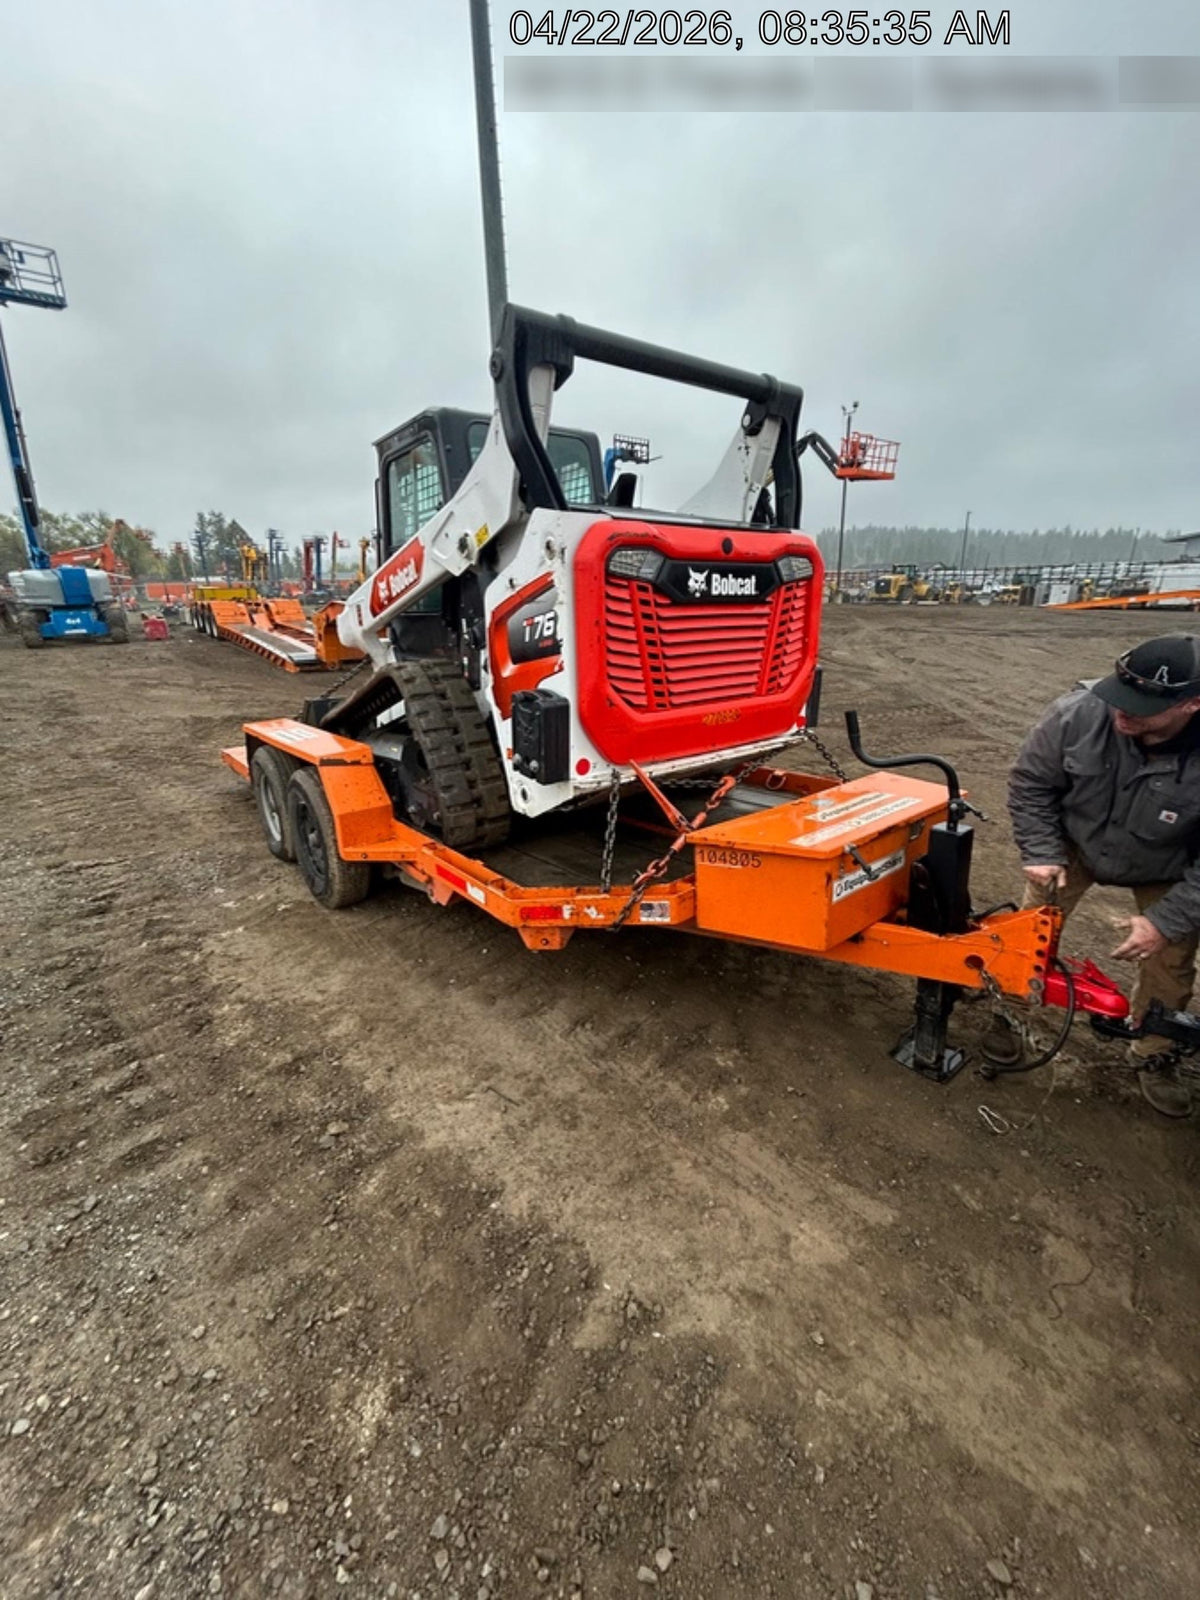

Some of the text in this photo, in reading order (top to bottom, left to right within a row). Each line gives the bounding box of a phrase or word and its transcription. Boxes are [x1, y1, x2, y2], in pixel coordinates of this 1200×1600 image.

[711, 573, 757, 596] Bobcat
[523, 611, 556, 643] T76
[698, 849, 762, 868] 104805
